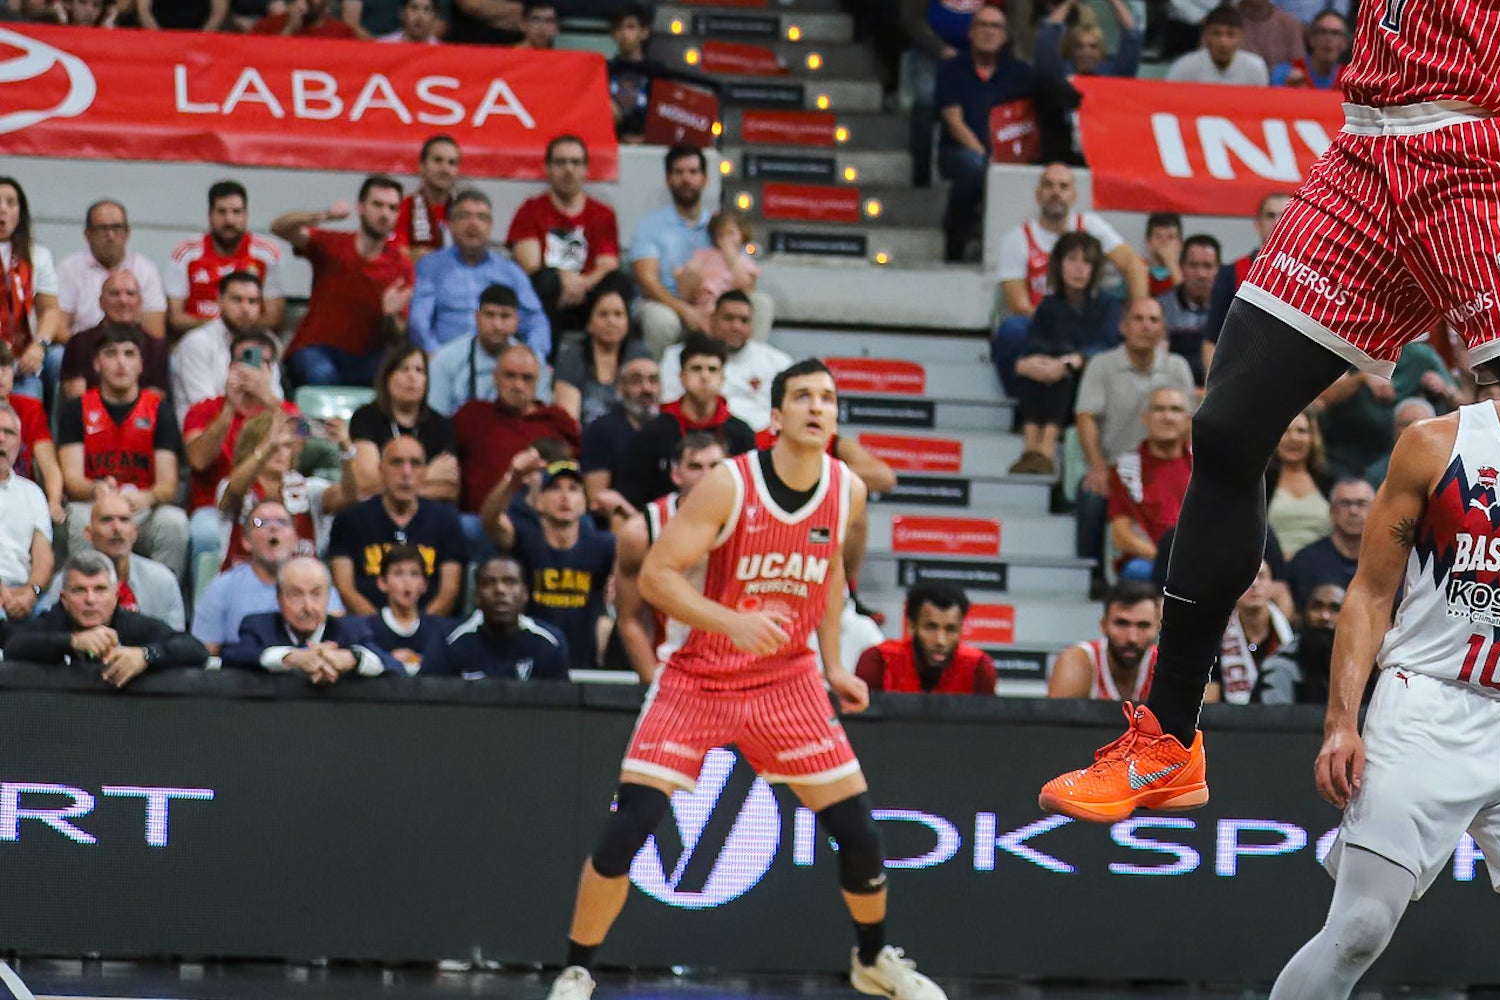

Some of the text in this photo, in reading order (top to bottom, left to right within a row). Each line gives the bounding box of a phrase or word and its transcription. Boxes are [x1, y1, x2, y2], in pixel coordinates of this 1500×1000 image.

[175, 65, 535, 128] LABASA
[1271, 250, 1353, 307] INVERSUS
[736, 551, 830, 585] UCAM
